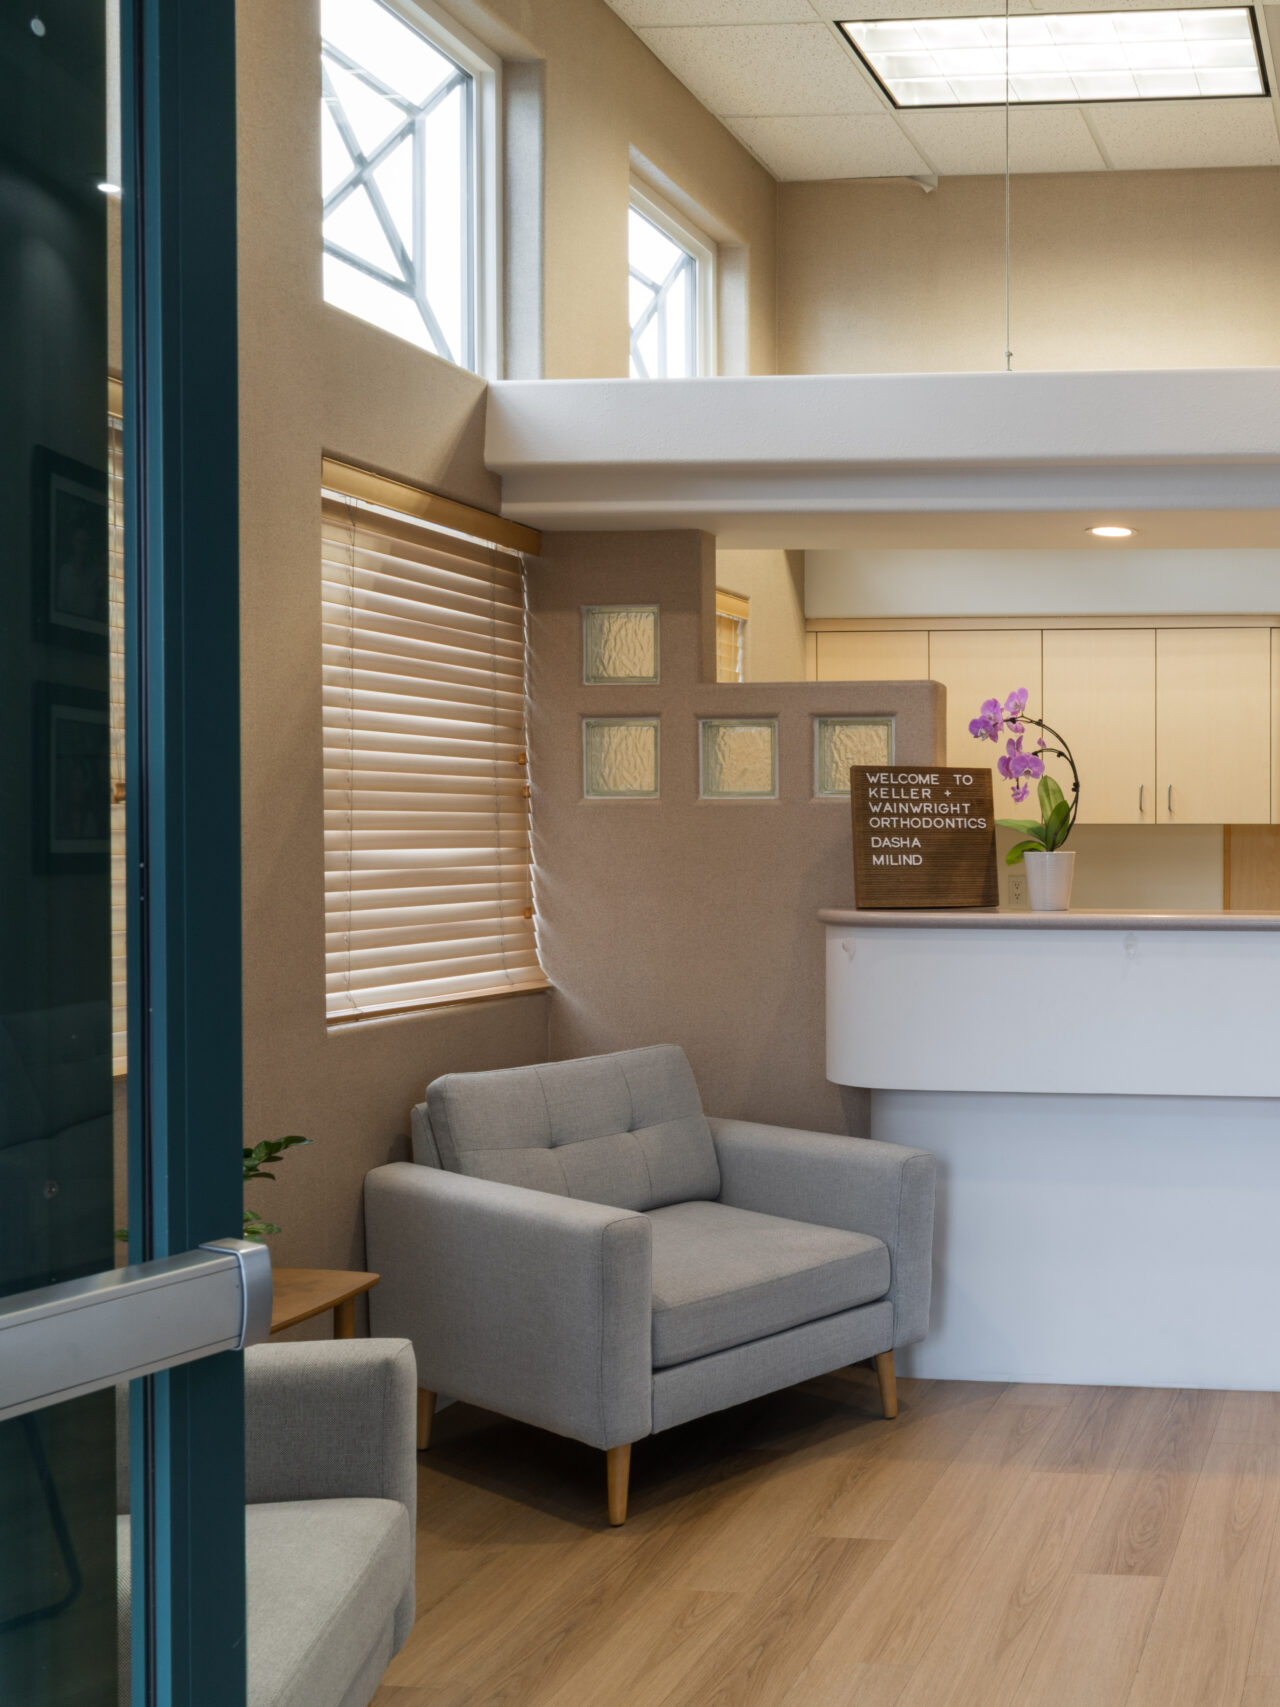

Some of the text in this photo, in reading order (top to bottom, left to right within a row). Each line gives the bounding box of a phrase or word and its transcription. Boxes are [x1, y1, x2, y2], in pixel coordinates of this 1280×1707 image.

[866, 772, 974, 786] WELCOME TO
[868, 787, 952, 799] KELLER +
[868, 802, 971, 815] WAINWRIGHT
[868, 817, 987, 829] ORTHODONTICS
[871, 836, 922, 849] DASHA
[872, 854, 923, 866] MILIND
